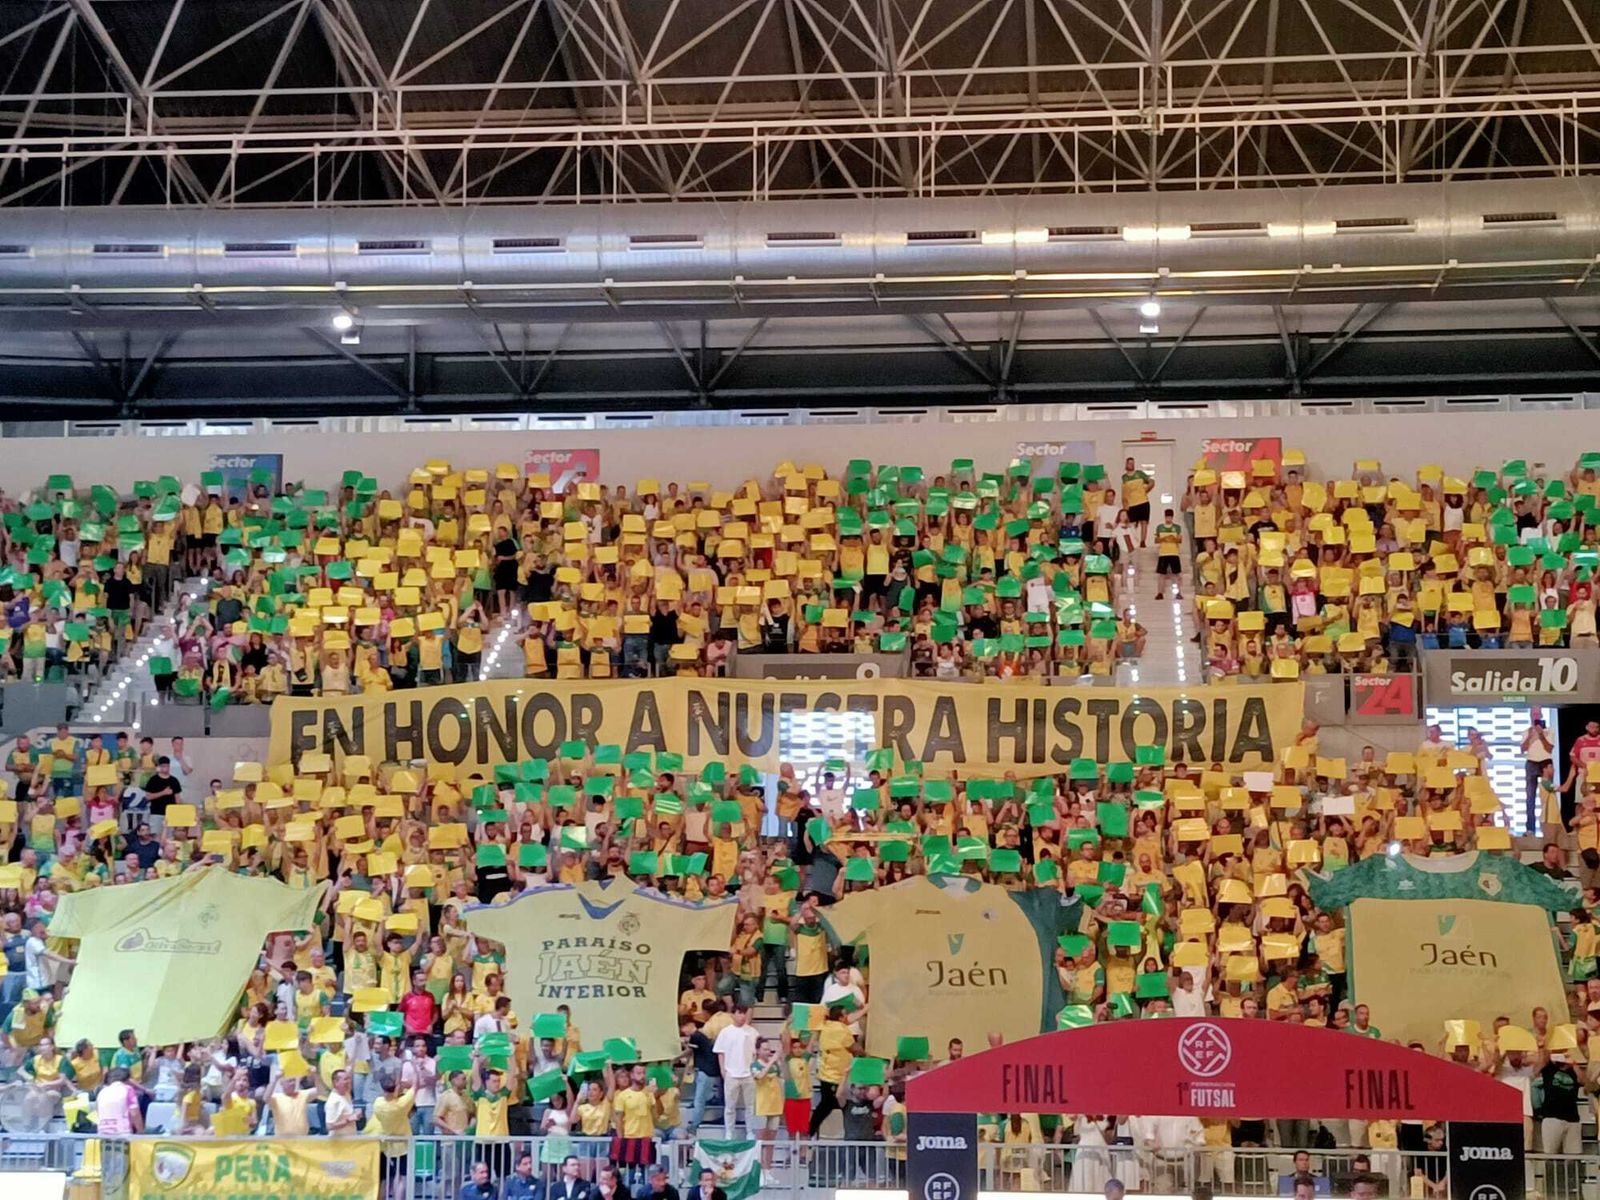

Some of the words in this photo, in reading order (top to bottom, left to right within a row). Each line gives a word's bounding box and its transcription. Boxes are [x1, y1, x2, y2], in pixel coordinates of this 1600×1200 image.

[525, 450, 572, 464] Sector
[1016, 443, 1067, 456] Sector
[1201, 440, 1253, 453] Sector
[210, 455, 257, 469] Sector
[1354, 676, 1392, 686] Sector
[1451, 670, 1537, 692] Salida
[1538, 657, 1578, 692] 10
[1356, 675, 1413, 715] 24
[290, 705, 365, 772] EN
[384, 692, 604, 765] HONOR
[625, 690, 669, 756] A
[986, 697, 1275, 765] HISTORIA
[542, 936, 652, 955] PARAÍSO
[1420, 943, 1498, 968] Jaén
[535, 949, 652, 985] JAÉN
[926, 960, 1008, 988] Jaén
[538, 984, 647, 999] INTERIOR
[1002, 1064, 1069, 1104] FINAL
[1345, 1069, 1414, 1110] FINAL
[1190, 1088, 1237, 1108] FUTSAL
[213, 1144, 292, 1185] PEÑA
